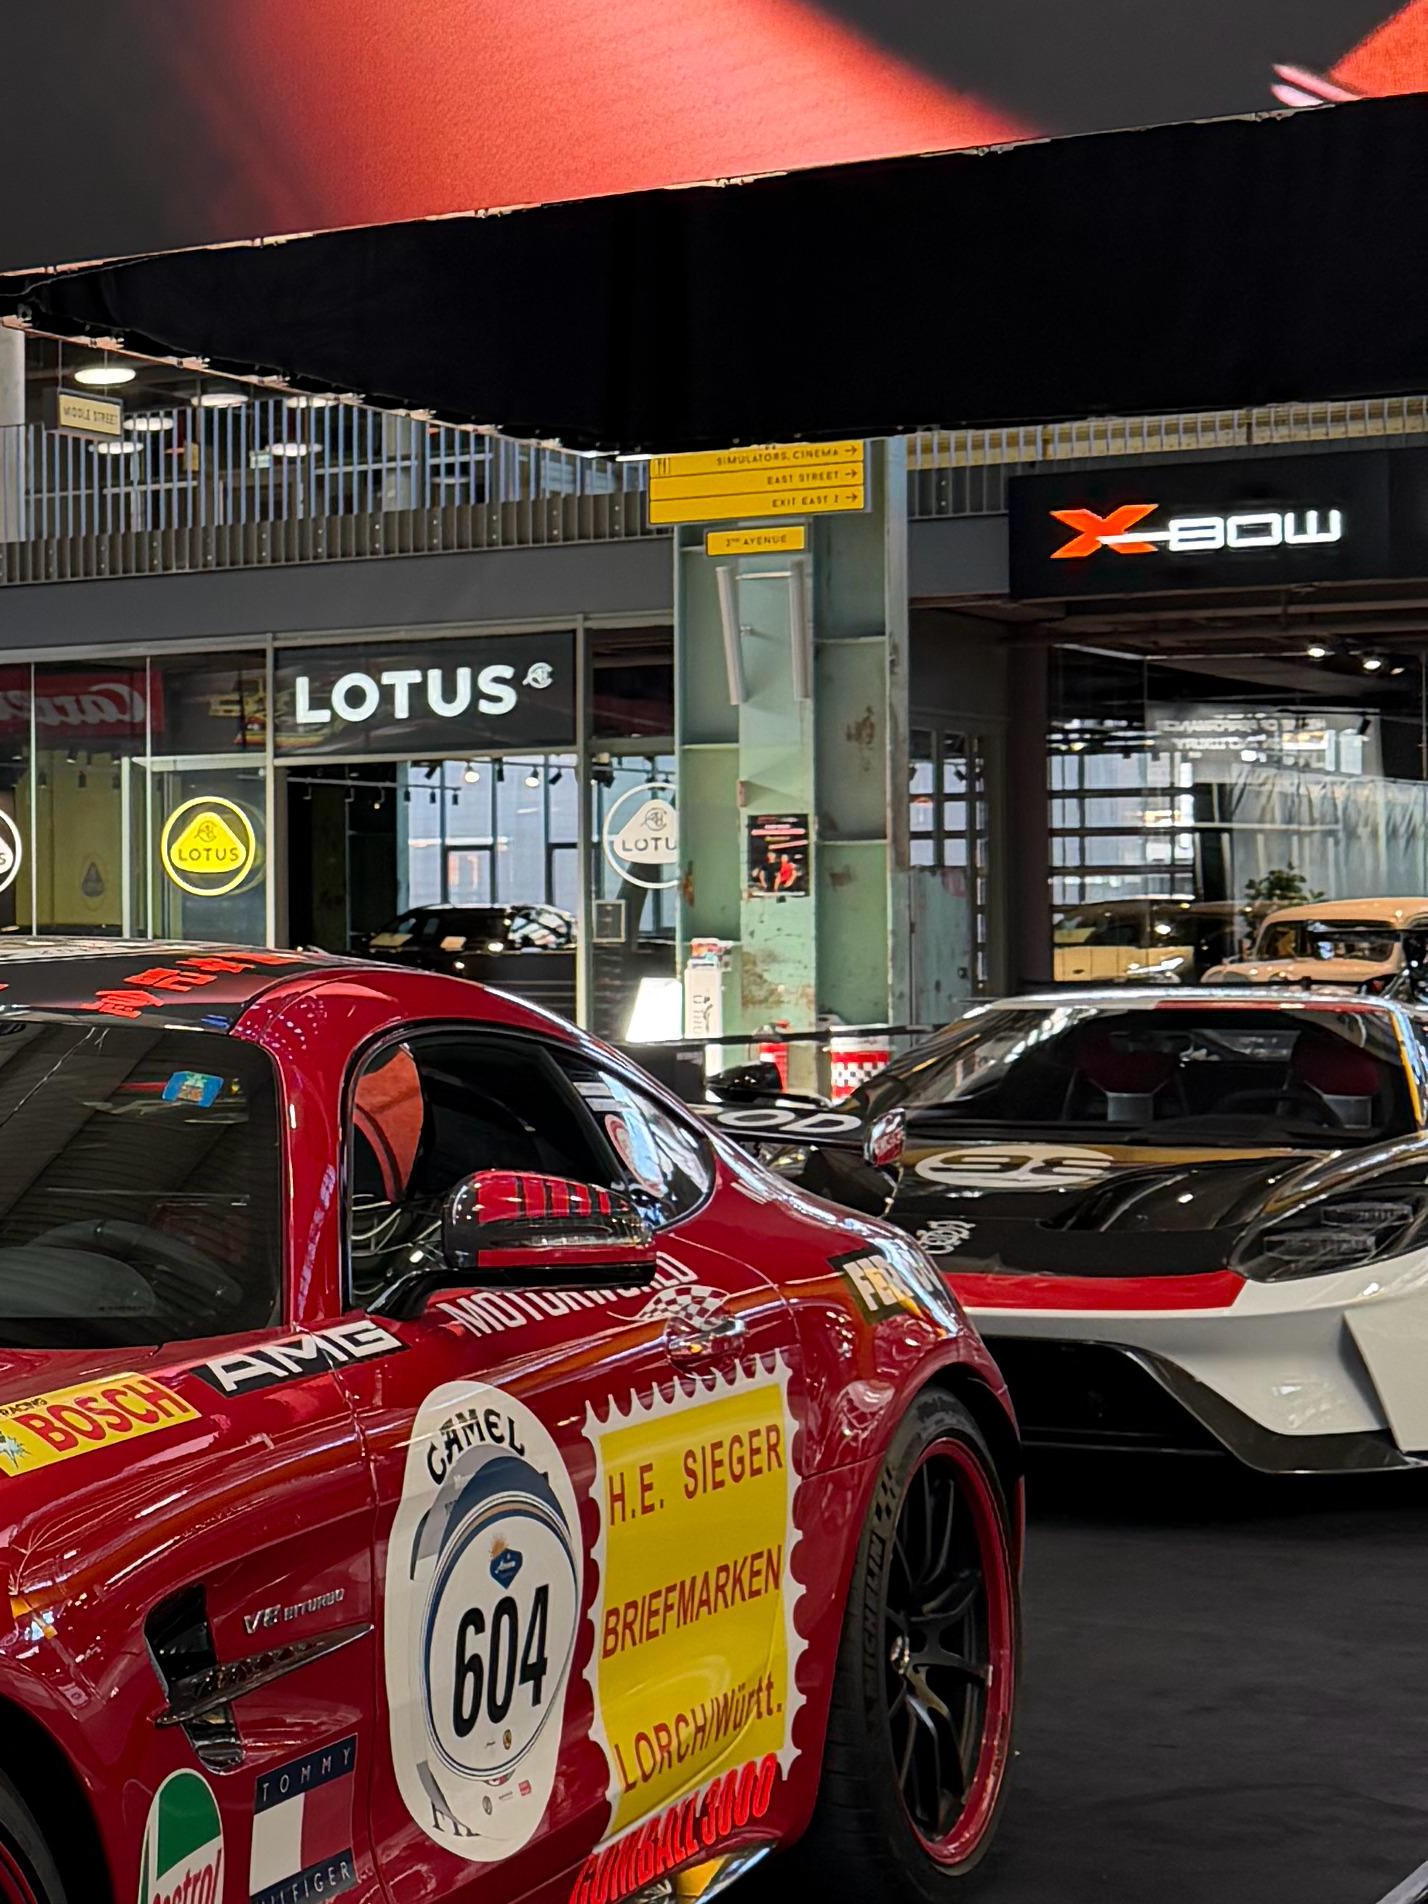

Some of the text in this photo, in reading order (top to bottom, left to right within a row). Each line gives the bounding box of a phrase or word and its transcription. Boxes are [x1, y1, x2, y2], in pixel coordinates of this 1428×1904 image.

[767, 470, 840, 485] EAST STREET
[792, 449, 840, 460] CINEMA
[771, 497, 796, 509] EXIT
[800, 495, 831, 507] EAST
[1050, 503, 1343, 561] X-BOW
[743, 534, 788, 547] AVENUE
[296, 663, 518, 726] LOTUS
[177, 845, 241, 865] LOTUS
[620, 837, 678, 856] LOTU
[206, 1321, 403, 1393] AMG
[22, 1378, 183, 1453] BOSCH
[426, 1408, 526, 1486] CAMEL
[609, 1423, 784, 1527] H.E. SIEGER
[243, 1587, 346, 1636] V8 BITURBO
[602, 1551, 782, 1661] BRIEFMARKEN
[452, 1584, 550, 1740] 604
[614, 1673, 783, 1794] LORCH/Württ.
[260, 1747, 353, 1802] TOMMY
[700, 1752, 779, 1846] 3000
